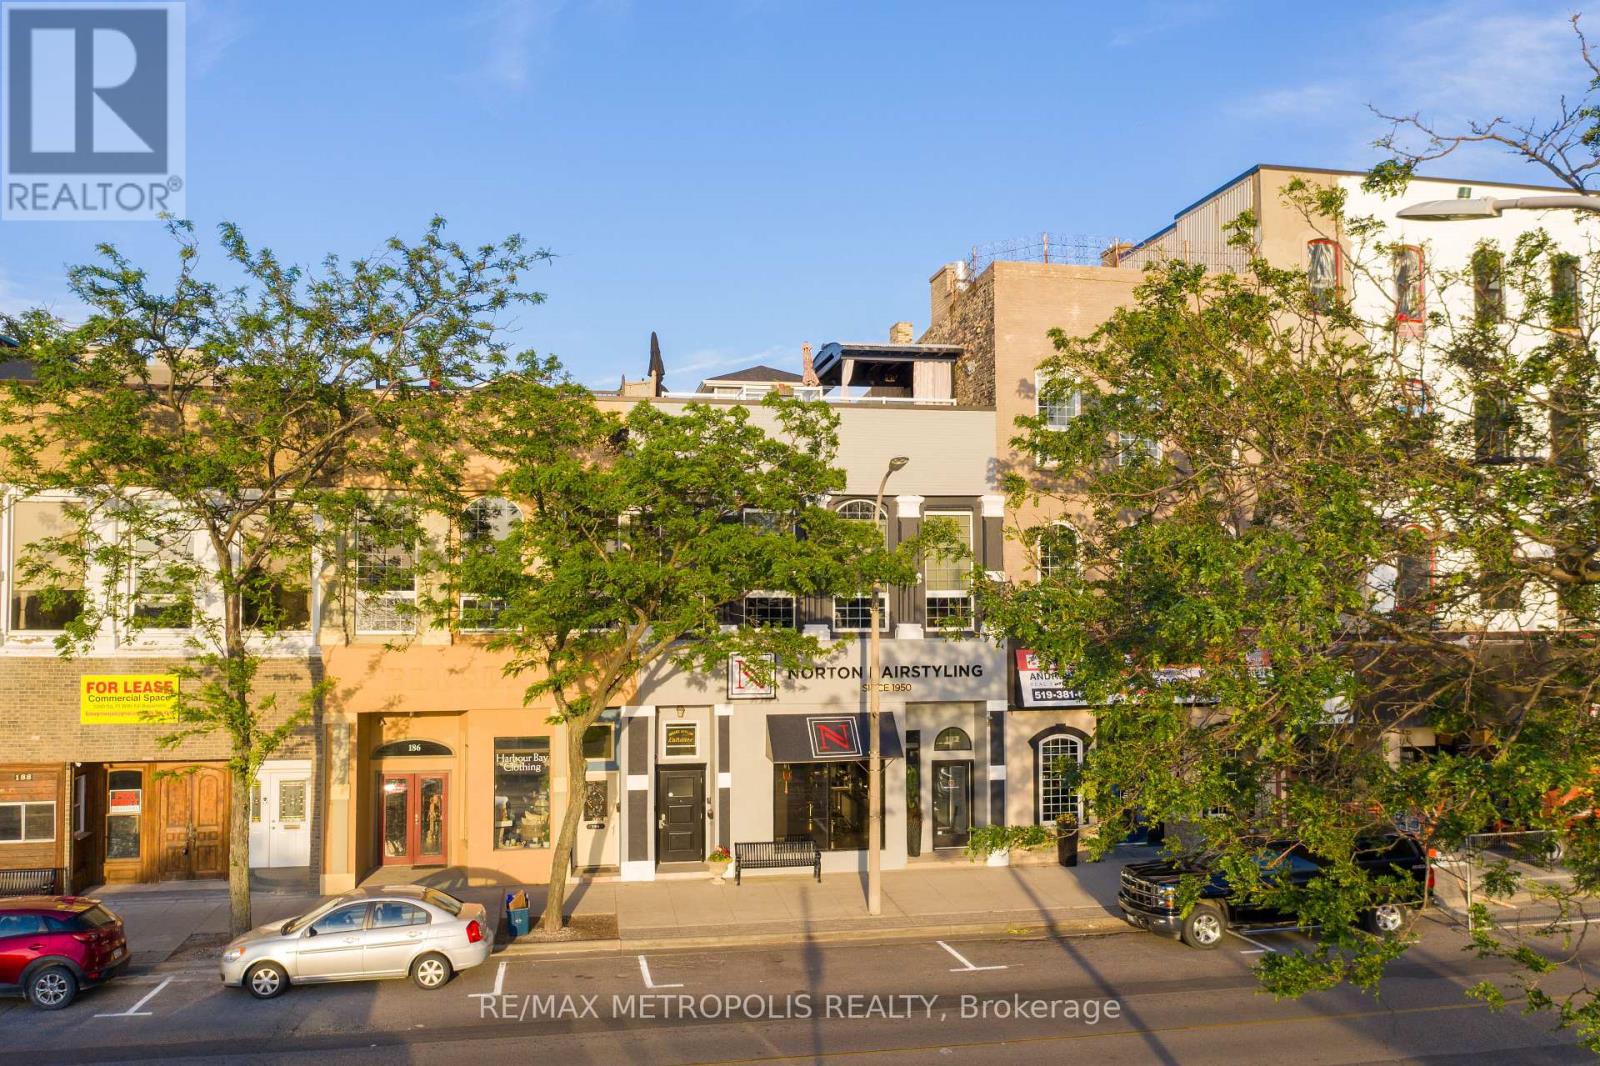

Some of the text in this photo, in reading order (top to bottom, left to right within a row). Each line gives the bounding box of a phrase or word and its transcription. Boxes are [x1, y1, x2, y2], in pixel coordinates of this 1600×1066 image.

[788, 665, 983, 680] NORTON AIRSTYLING
[86, 681, 174, 694] FOR LEASE
[862, 684, 912, 692] SICE 1950
[88, 694, 141, 703] Commercial
[818, 723, 849, 750] N
[496, 753, 549, 763] Harbour Bay
[503, 762, 541, 773] Clothing
